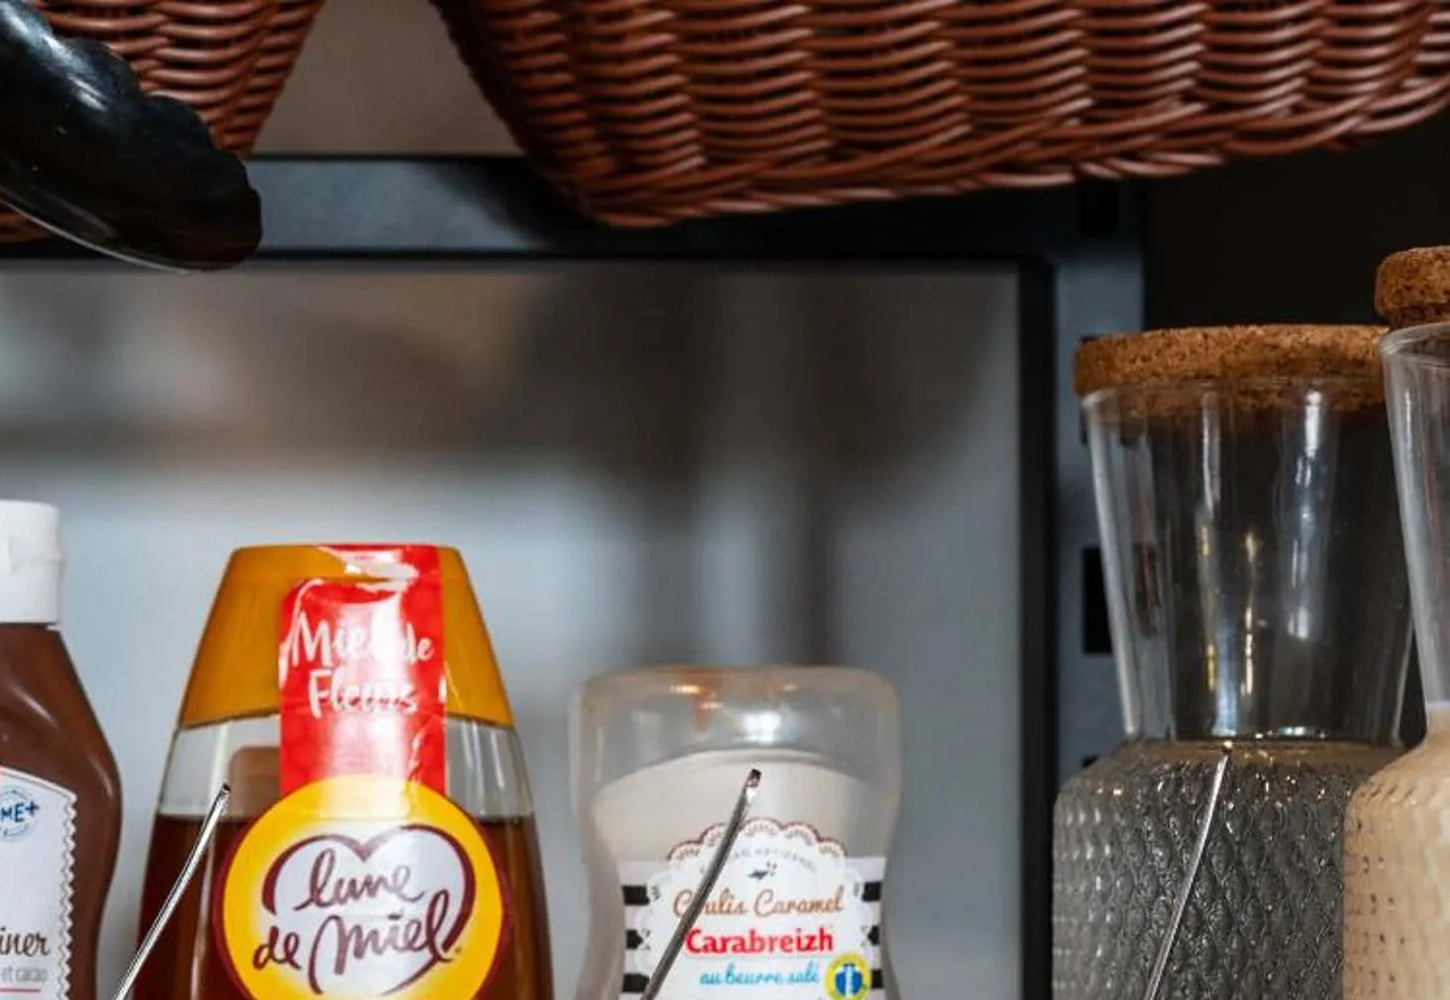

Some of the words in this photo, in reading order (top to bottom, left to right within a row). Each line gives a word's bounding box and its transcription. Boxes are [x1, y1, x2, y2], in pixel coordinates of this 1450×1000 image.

[753, 884, 844, 918] Caramel
[253, 926, 302, 971] de
[686, 926, 834, 954] Carabreizh
[699, 970, 721, 985] au
[725, 963, 785, 986] beurre
